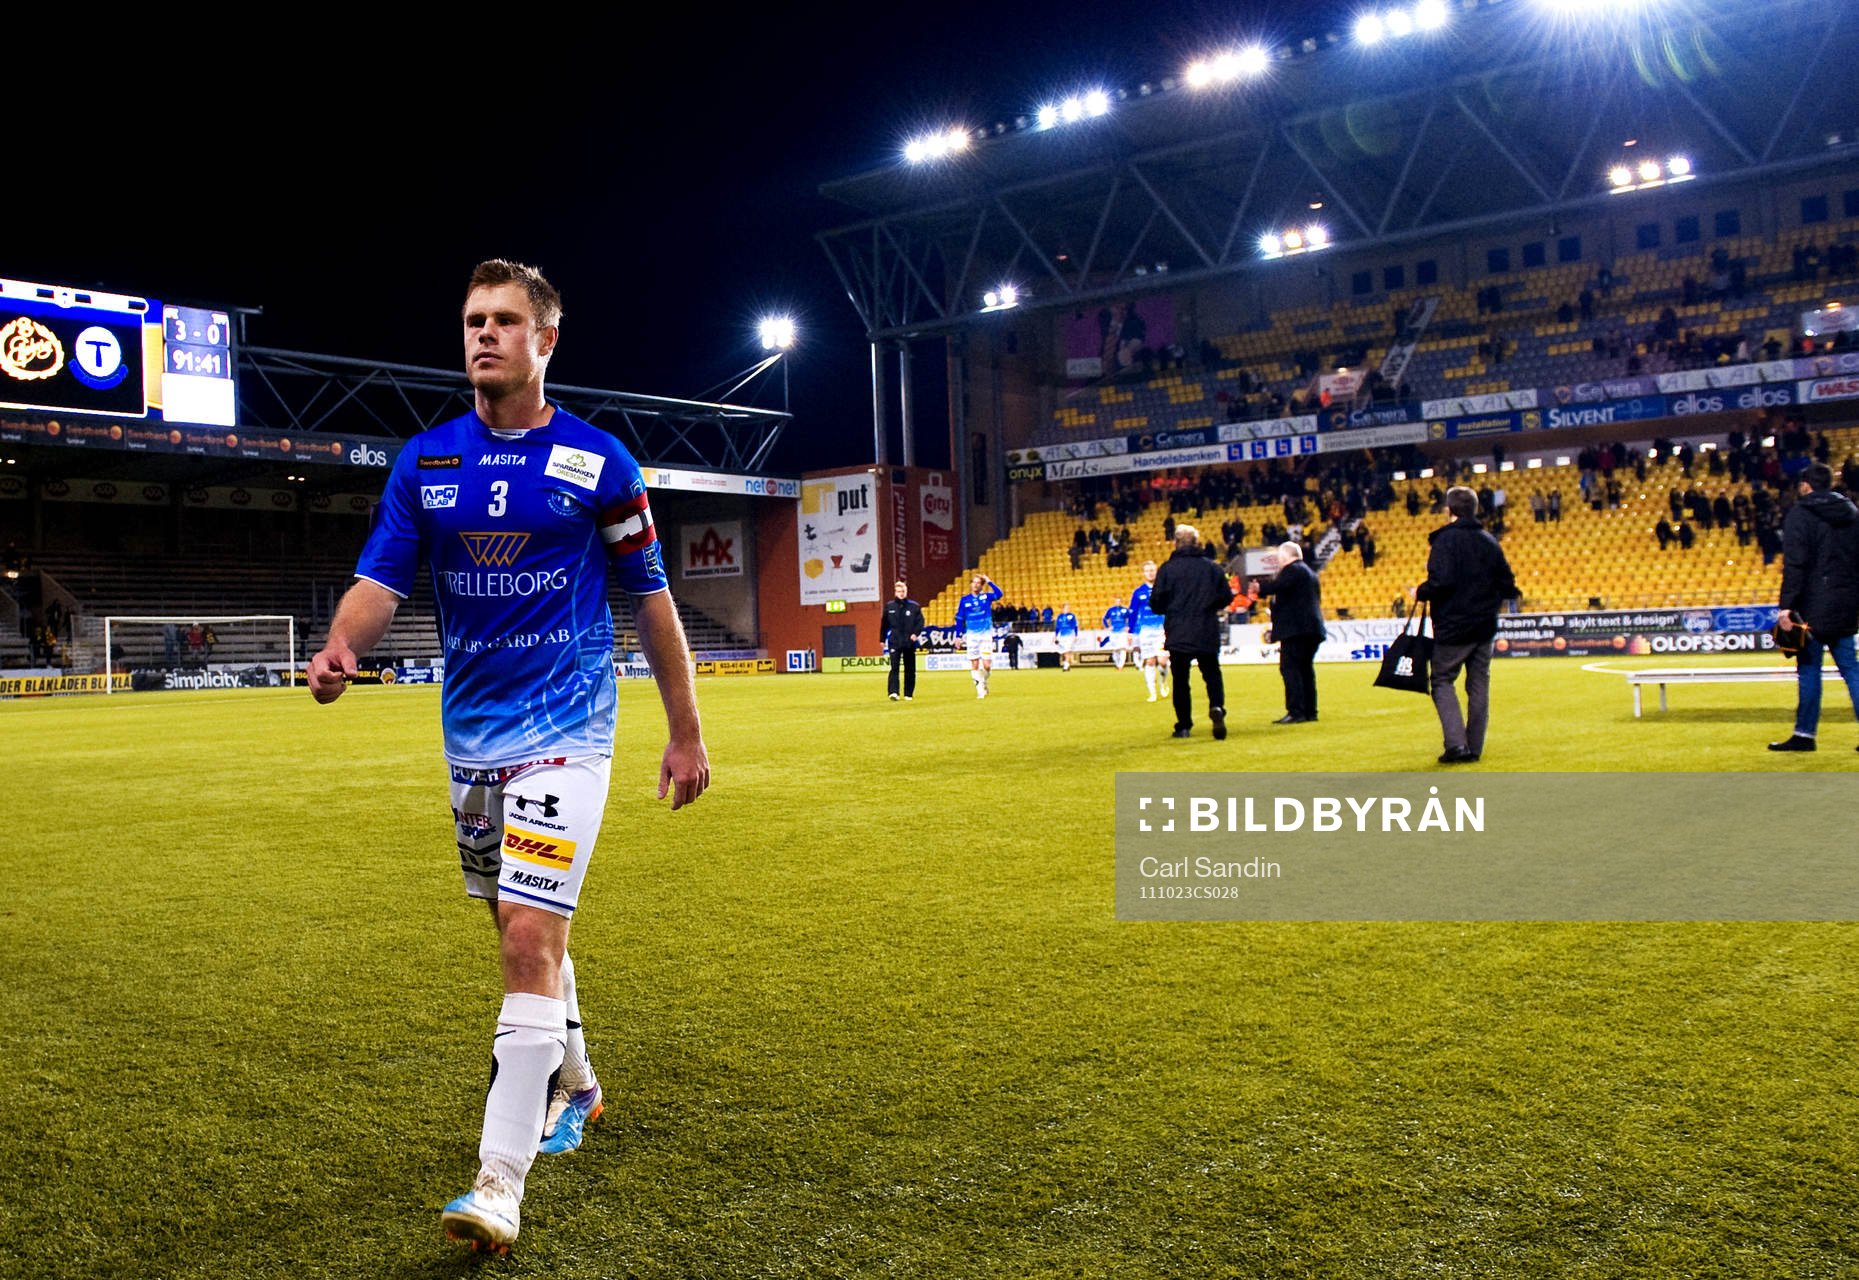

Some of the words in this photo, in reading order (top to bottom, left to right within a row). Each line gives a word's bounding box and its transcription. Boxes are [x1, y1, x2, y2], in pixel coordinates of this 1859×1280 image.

[176, 320, 186, 340] 3
[208, 324, 220, 344] 0
[173, 350, 220, 374] 91:41
[1674, 393, 1723, 415] ellos
[1739, 387, 1791, 409] ellos
[350, 444, 387, 466] ellos
[478, 454, 527, 465] MASITA
[1133, 450, 1220, 467] Handelsbanken
[552, 462, 595, 479] SPARBANKEN
[1009, 466, 1042, 480] onyx
[1049, 461, 1099, 478] Marks
[488, 480, 509, 517] 3
[894, 491, 907, 580] nalleland
[690, 527, 734, 567] MAX
[439, 568, 567, 597] TRELLEBORG
[1539, 616, 1565, 627] AB
[1569, 617, 1596, 630] skylt
[1598, 616, 1621, 627] text
[1623, 616, 1632, 626] &
[1634, 614, 1674, 628] design
[544, 629, 570, 644] AB
[1652, 632, 1755, 652] OLOFSSON
[841, 657, 890, 667] DEADLIN
[509, 811, 528, 823] UNDER
[529, 818, 566, 831] ARMOUR
[505, 833, 561, 860] DHL
[510, 871, 561, 892] MASITA
